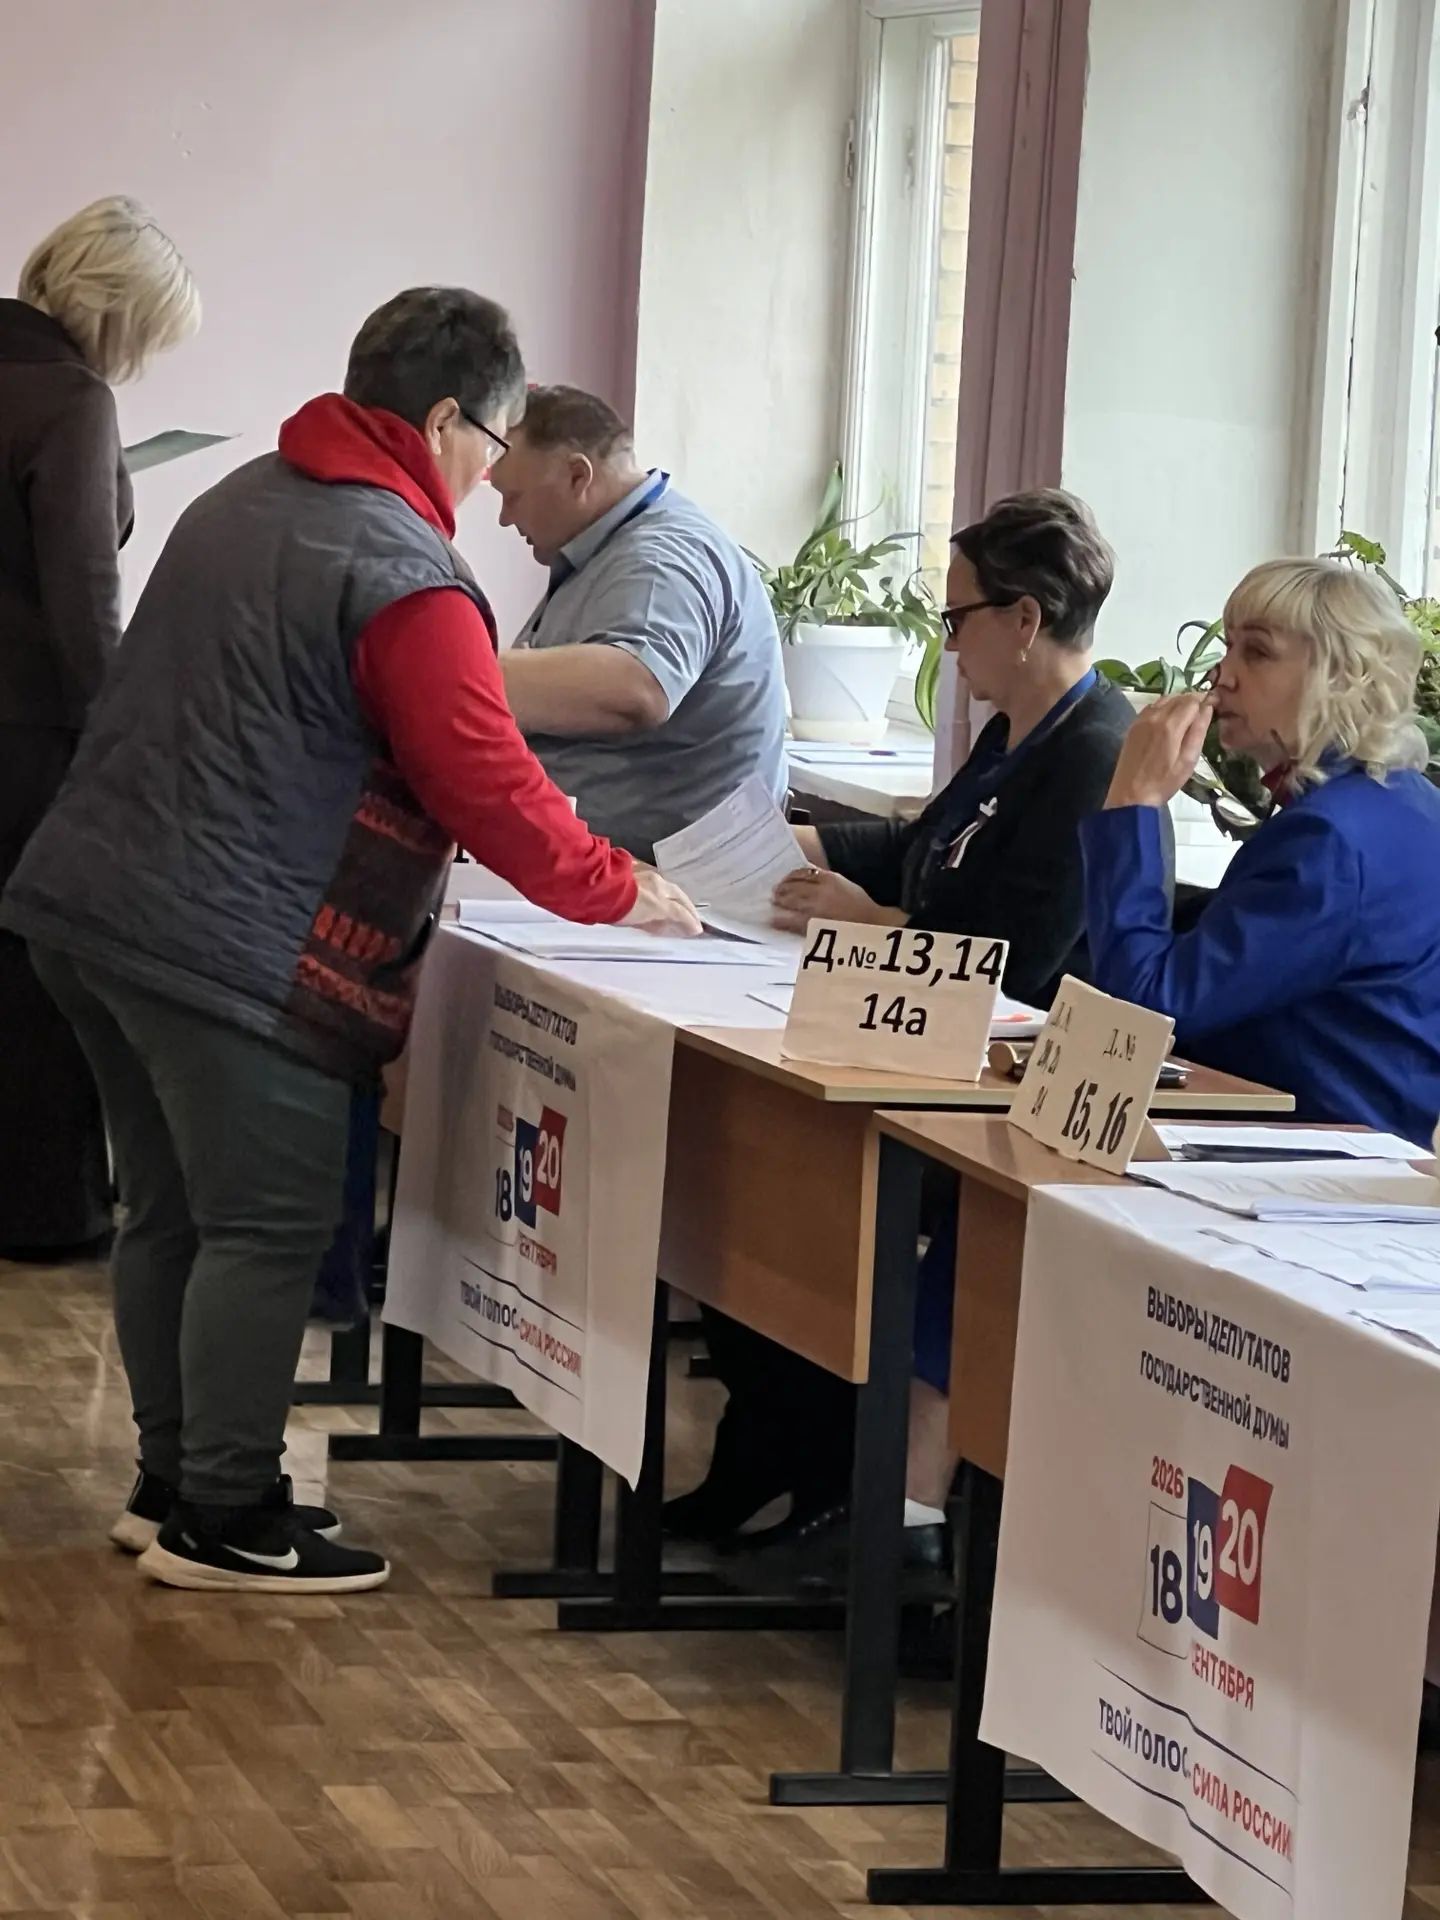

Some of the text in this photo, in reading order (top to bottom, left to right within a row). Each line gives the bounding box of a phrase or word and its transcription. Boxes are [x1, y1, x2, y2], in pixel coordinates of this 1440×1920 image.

[859, 993, 927, 1035] 14а
[496, 1167, 512, 1222] 18
[536, 1130, 560, 1189] 20
[1147, 1286, 1291, 1383] ВЫБОРЫ ДЕПУТАТОВ
[1253, 1406, 1290, 1449] ДУМЫ
[1152, 1456, 1184, 1499] 2026
[1150, 1499, 1259, 1624] 18 19 20
[1192, 1642, 1254, 1711] ЕНТЯБРЯ
[1099, 1697, 1132, 1749] ТВОЙ
[1192, 1763, 1228, 1818] СИЛА
